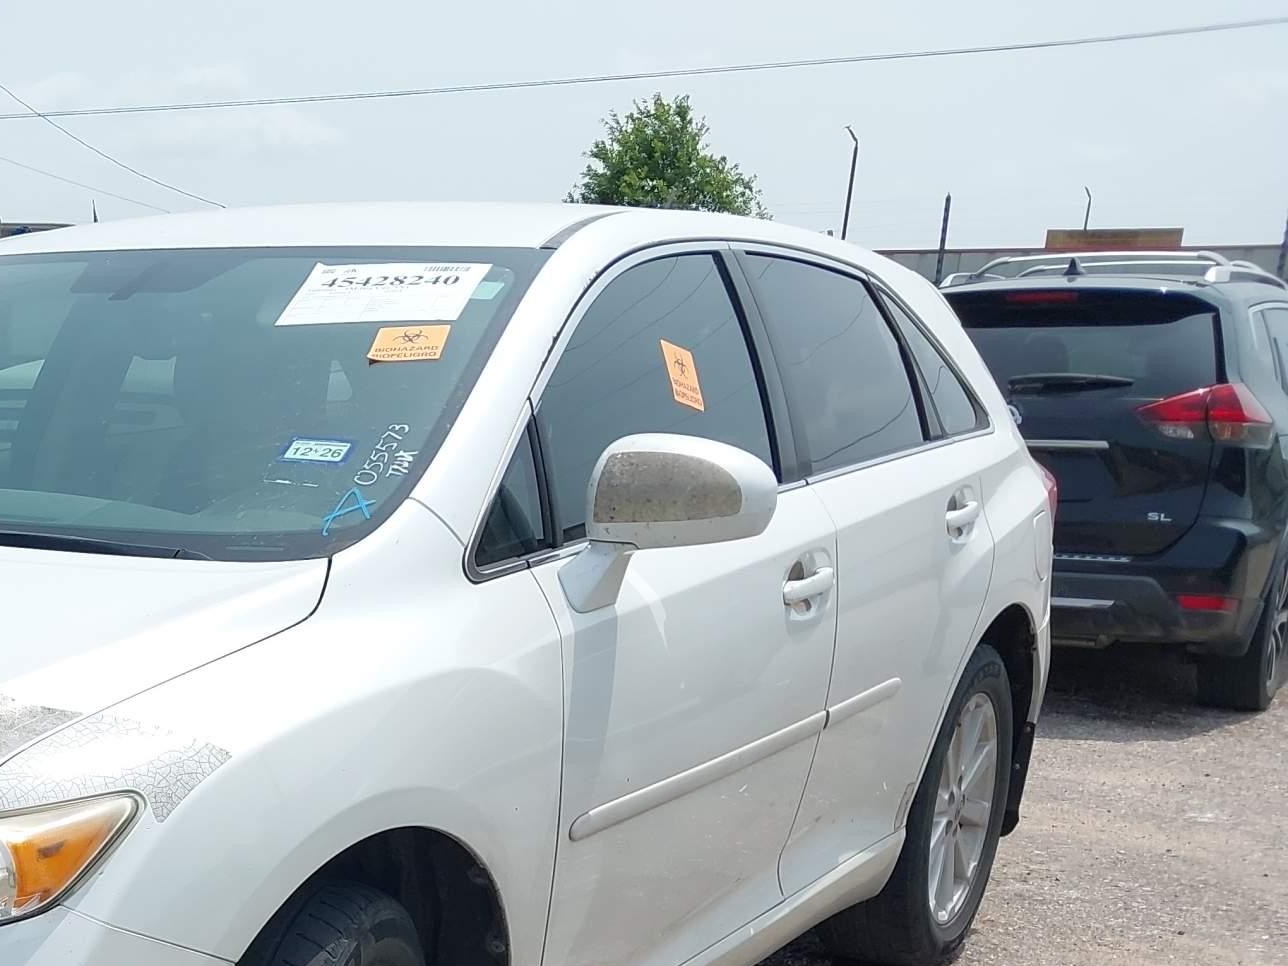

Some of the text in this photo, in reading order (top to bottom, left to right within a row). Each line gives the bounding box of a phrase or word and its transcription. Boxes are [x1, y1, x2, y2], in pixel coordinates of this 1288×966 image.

[321, 275, 460, 288] 45428240
[375, 345, 439, 353] BIOHAZARD
[293, 446, 343, 458] 12 26
[354, 424, 409, 485] 055573
[1147, 512, 1172, 522] SL
